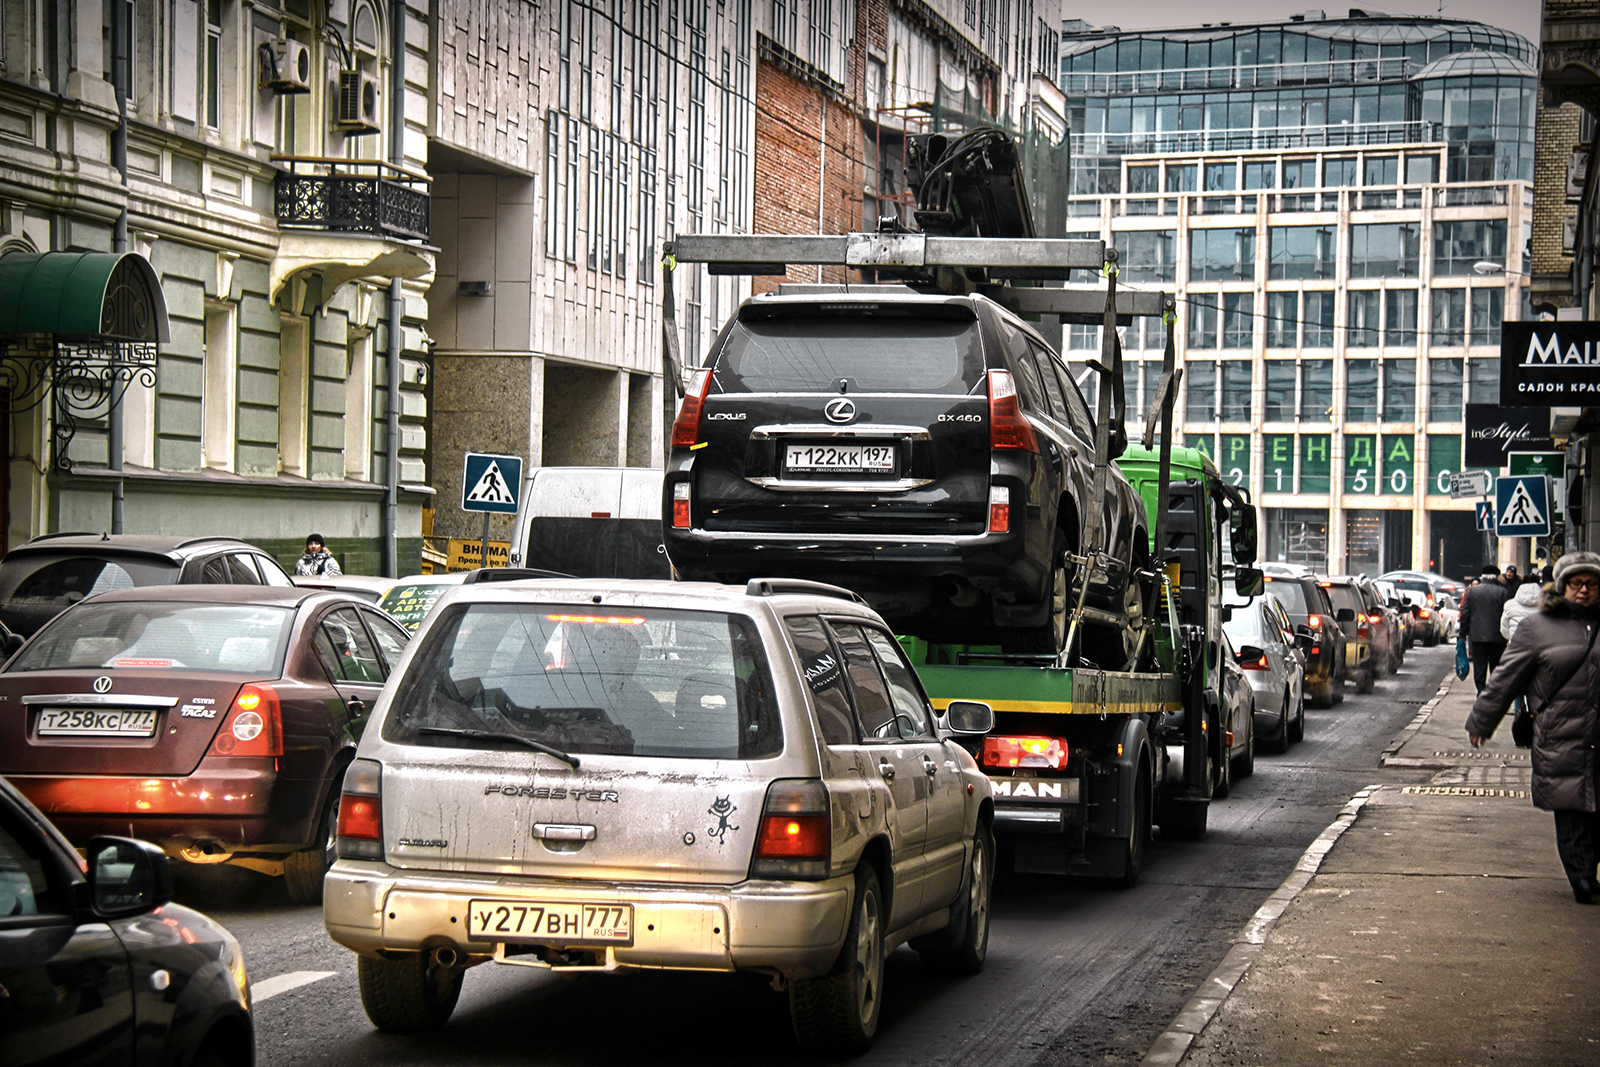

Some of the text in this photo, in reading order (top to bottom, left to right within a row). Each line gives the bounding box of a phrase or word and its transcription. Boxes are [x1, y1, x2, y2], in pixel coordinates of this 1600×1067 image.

[1518, 383, 1564, 392] САЛОН
[708, 412, 747, 421] LEXUS
[937, 414, 982, 423] GX 460
[793, 447, 889, 465] Т122КК 197
[1193, 437, 1411, 467] АРЕНДА
[47, 710, 151, 729] Т258КС 777
[181, 708, 217, 718] TAGAZ
[484, 785, 618, 803] FORESTER
[990, 781, 1062, 798] MAN
[480, 906, 624, 934] У277ВН 777
[594, 928, 613, 936] RUS
